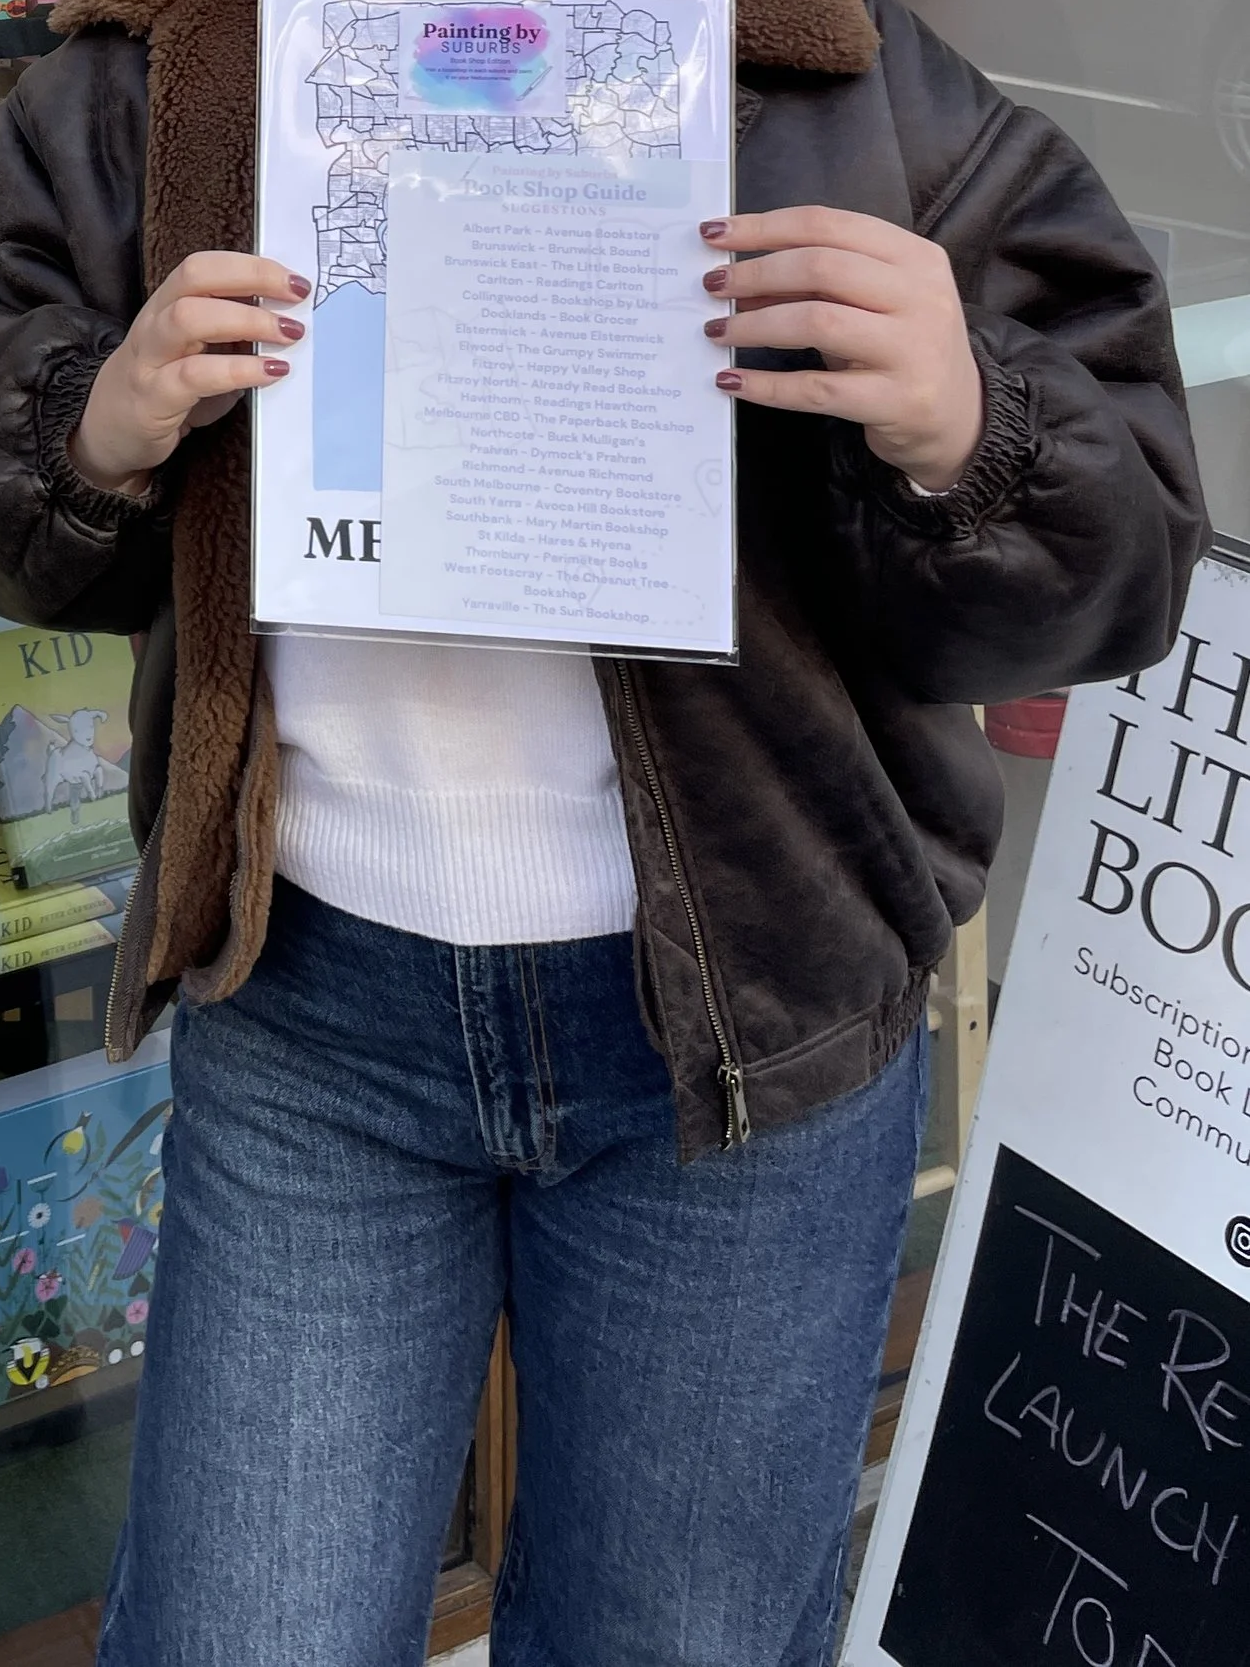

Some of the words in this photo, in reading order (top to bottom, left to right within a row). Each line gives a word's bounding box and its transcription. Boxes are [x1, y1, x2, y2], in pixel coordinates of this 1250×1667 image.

[423, 23, 512, 44] Painting
[516, 23, 541, 42] by
[441, 41, 521, 54] SUBURBS
[463, 178, 518, 197] Book
[523, 179, 578, 202] Shop
[583, 182, 647, 201] Guide
[501, 202, 607, 216] SUGGESTIONS
[463, 223, 500, 234] Albert
[504, 224, 531, 235] Park
[546, 227, 592, 239] Avenue
[595, 229, 660, 241] Bookstore
[472, 240, 535, 253] Brunswick
[548, 244, 606, 256] Brunwick
[609, 246, 650, 258] Bound
[444, 256, 508, 268] Brunswick
[511, 260, 538, 270] East
[551, 261, 574, 272] The
[577, 262, 610, 273] Little
[613, 264, 678, 276] Bookroom
[450, 493, 485, 505] South
[489, 496, 522, 508] Yarra
[535, 500, 574, 512] Avoca
[577, 502, 597, 513] Hill
[600, 504, 665, 519] Bookstore
[444, 562, 476, 574] West
[480, 565, 542, 580] Footscray
[556, 570, 579, 582] The
[583, 572, 637, 587] Chesnut
[641, 576, 669, 589] Tree
[461, 598, 520, 612] Yarraville
[533, 603, 555, 615] The
[560, 605, 583, 617] Sun
[586, 607, 649, 623] Bookshop
[17, 632, 94, 680] KID
[1154, 1037, 1231, 1105] Book
[1013, 1204, 1148, 1369] THE
[1160, 1308, 1250, 1451] RE
[983, 1350, 1240, 1586] LAUNCH
